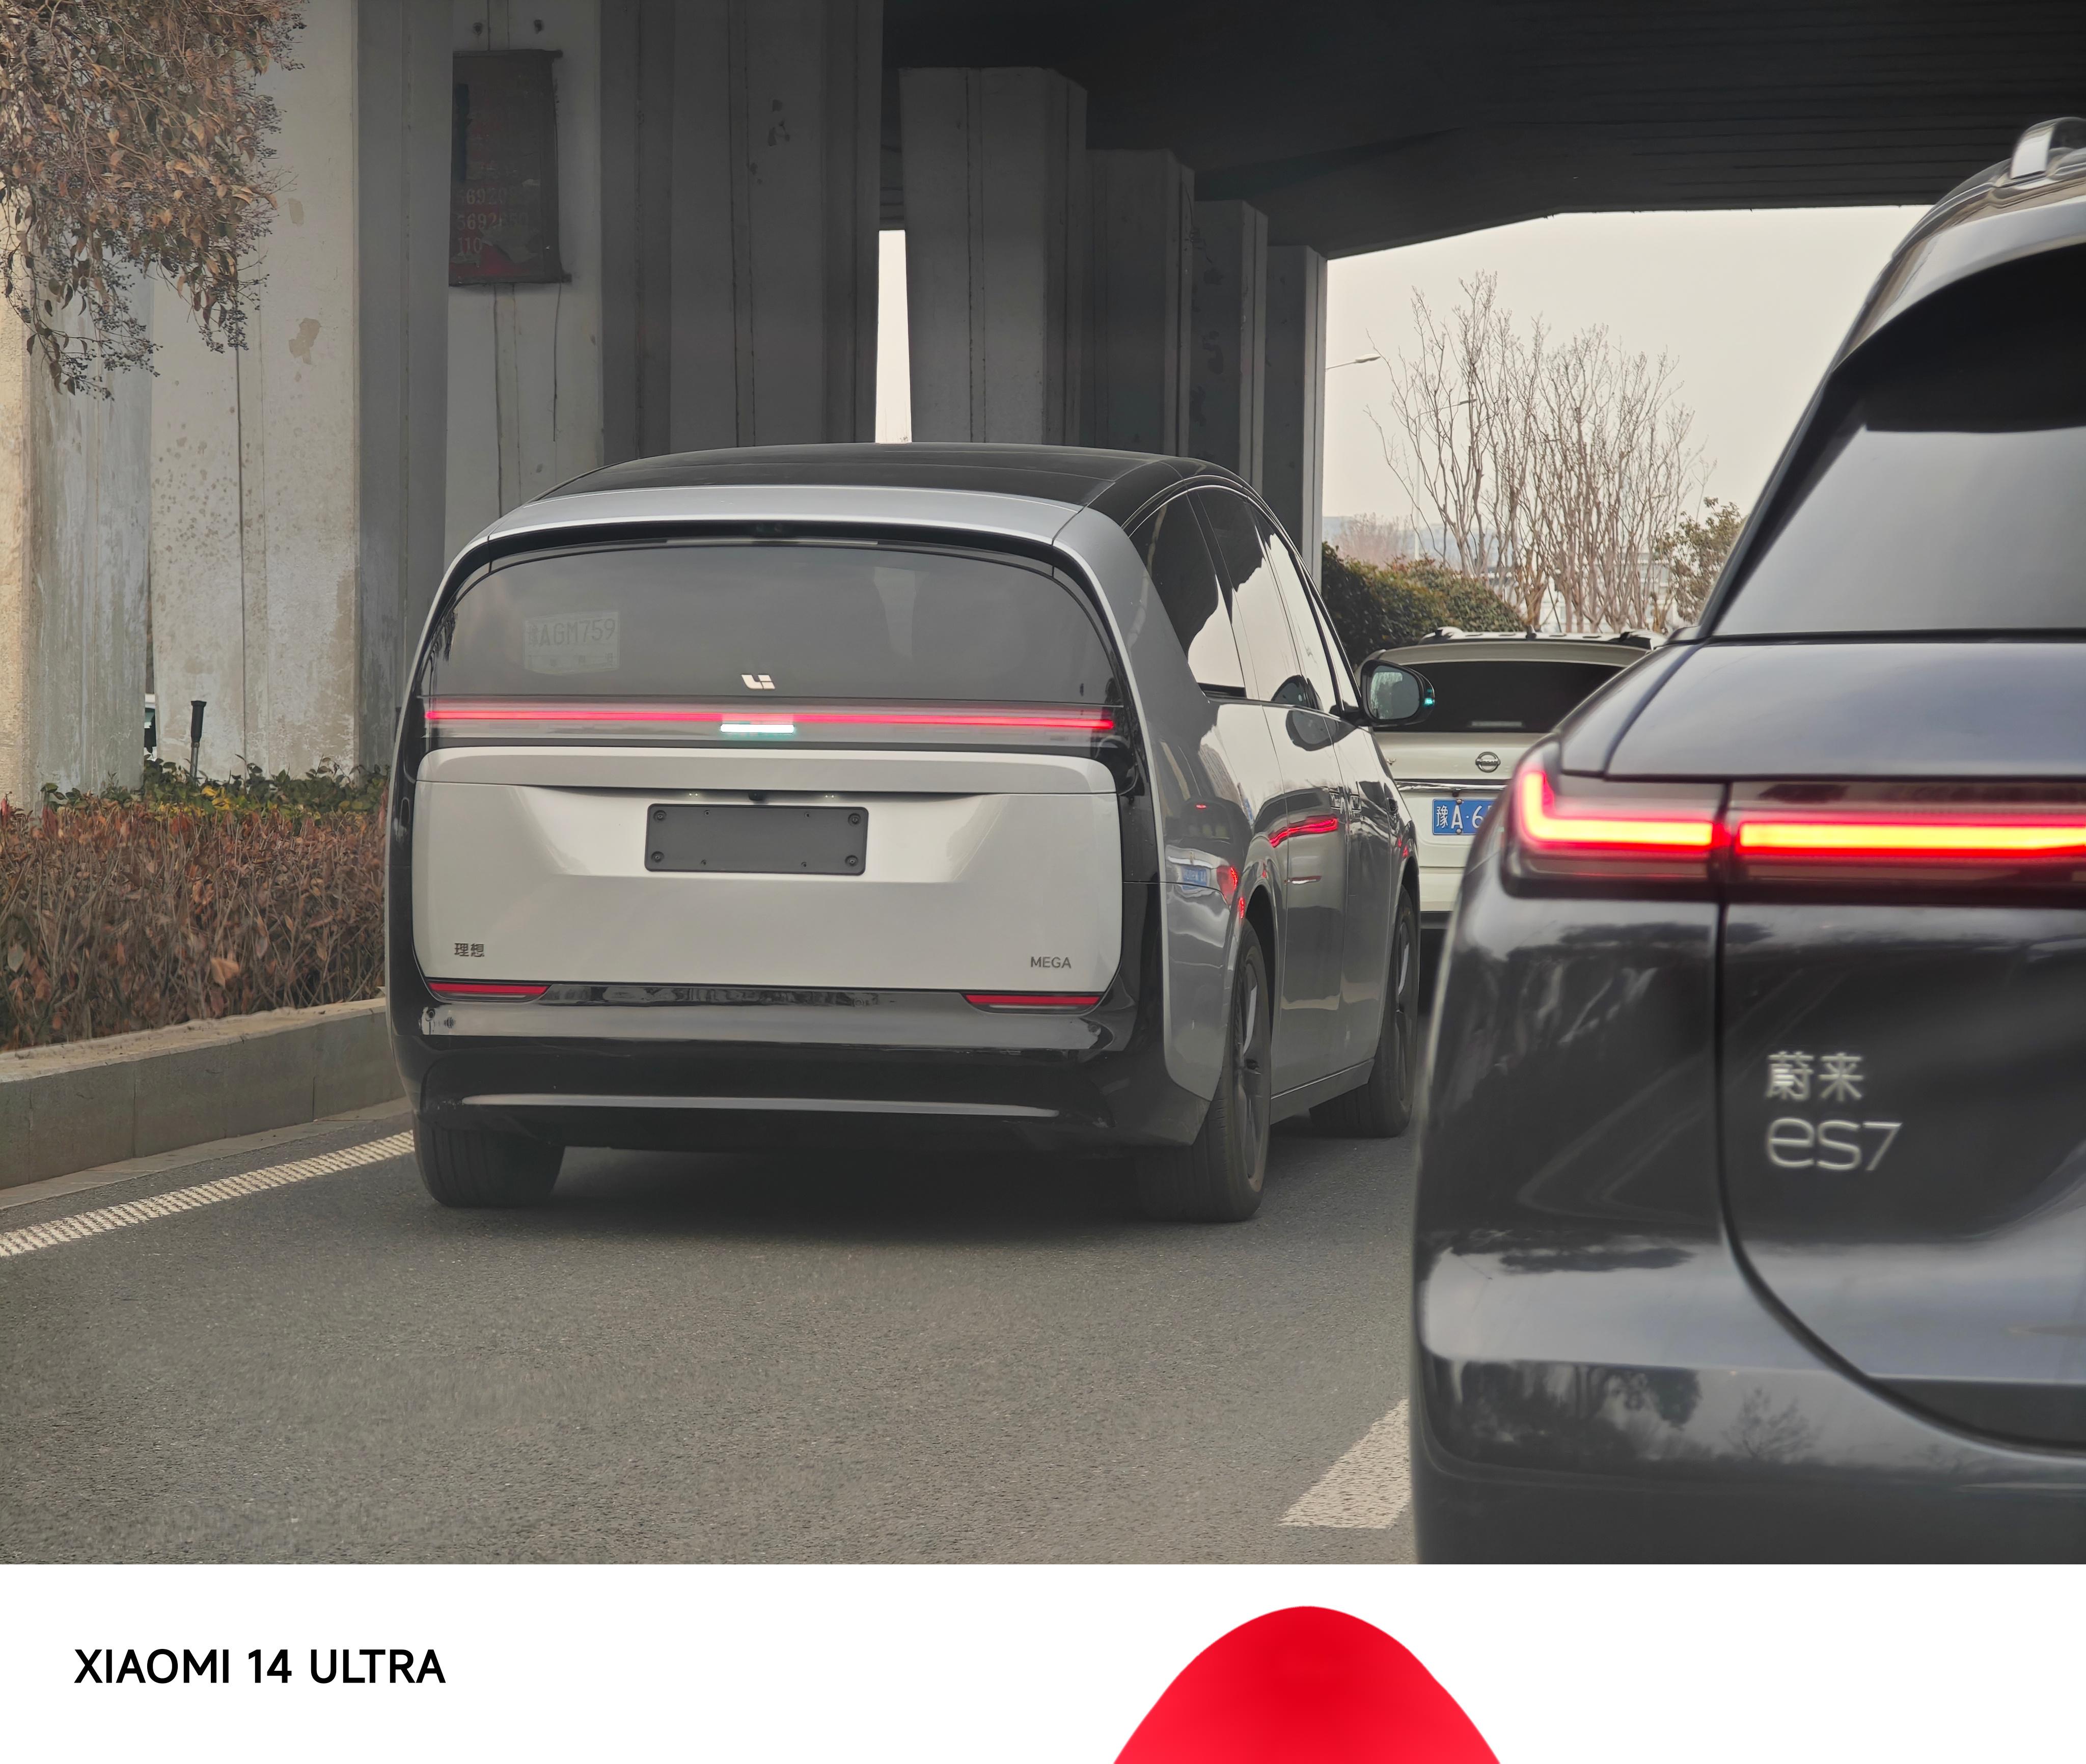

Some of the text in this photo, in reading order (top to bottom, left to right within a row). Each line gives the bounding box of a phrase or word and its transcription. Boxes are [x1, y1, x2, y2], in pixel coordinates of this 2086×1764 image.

[1436, 805, 1492, 829] 豫A·6
[454, 942, 485, 957] 理想
[1031, 956, 1072, 969] MEGA
[1766, 1051, 1865, 1101] 蔚来
